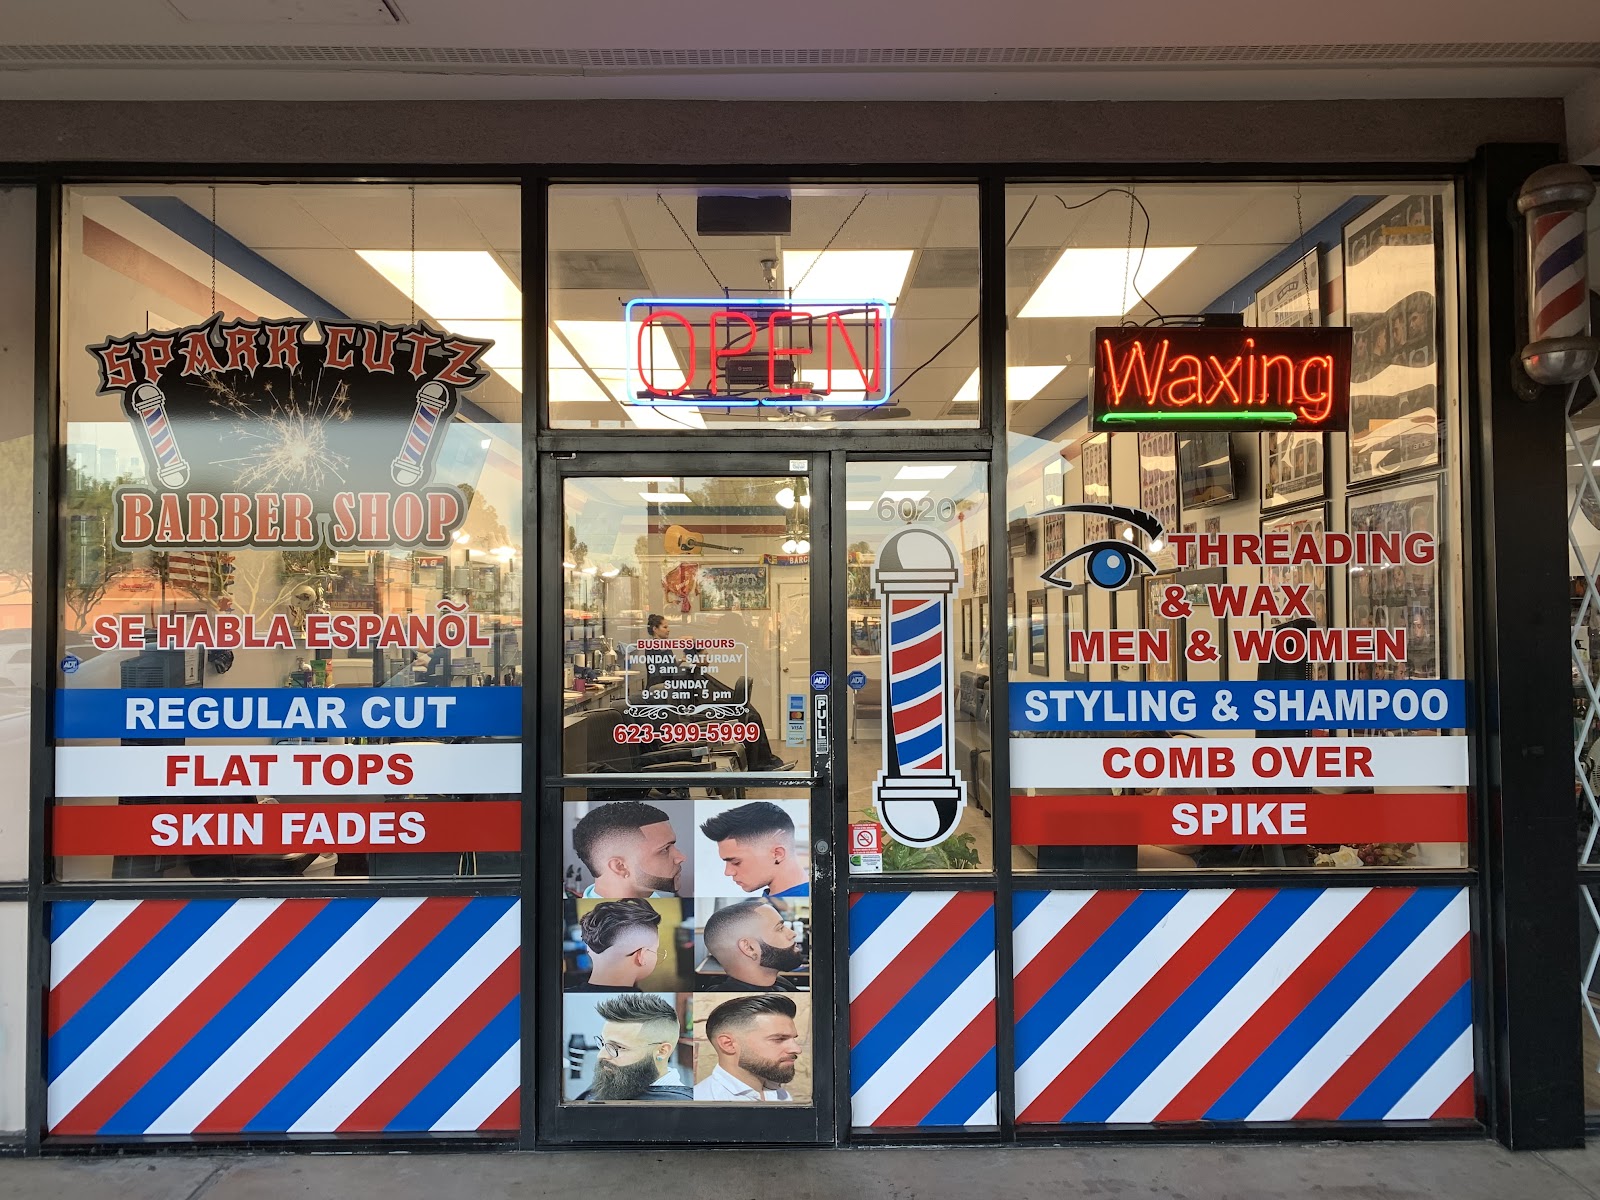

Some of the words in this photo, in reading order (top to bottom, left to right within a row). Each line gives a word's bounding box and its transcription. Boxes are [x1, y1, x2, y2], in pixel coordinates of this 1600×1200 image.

[101, 324, 300, 388] SPARK
[325, 324, 481, 384] CUTZ
[637, 308, 880, 397] OPEN
[1103, 338, 1334, 421] Waxing
[121, 493, 314, 542] BARBER
[333, 492, 460, 541] SHOP
[877, 497, 956, 522] 6020
[789, 555, 810, 565] BARC
[1167, 531, 1437, 567] THREADING
[1160, 584, 1194, 619] &
[1208, 584, 1312, 618] WAX
[92, 614, 146, 650] SE
[157, 614, 296, 650] HABLA
[637, 639, 694, 650] BUSINESS
[696, 639, 736, 650] HOURS
[1068, 628, 1172, 663] MEN
[1185, 628, 1221, 663] &
[1233, 628, 1408, 663] WOMEN
[64, 661, 77, 669] ADT
[629, 654, 677, 664] MONDAY
[685, 653, 743, 664] SATURDAY
[648, 664, 656, 674] 9
[659, 666, 678, 674] am
[690, 664, 697, 674] 7
[700, 666, 719, 675] pm
[664, 680, 709, 690] SUNDAY
[671, 691, 690, 699] am
[702, 690, 709, 700] 5
[712, 691, 732, 701] pm
[814, 677, 827, 685] ADT
[850, 676, 864, 685] ADT
[125, 696, 346, 730] REGULAR
[361, 696, 456, 729] CUT
[817, 699, 827, 739] PULL
[1024, 690, 1197, 722] STYLING
[1211, 690, 1240, 722] &
[1252, 689, 1449, 721] SHAMPOO
[614, 723, 759, 743] 623-399-5999
[166, 755, 278, 787] FLAT
[294, 754, 414, 786] TOPS
[1102, 746, 1236, 779] COMB
[1251, 746, 1375, 779] OVER
[150, 813, 264, 846] SKIN
[281, 812, 426, 846] FADES
[1171, 803, 1307, 836] SPIKE
